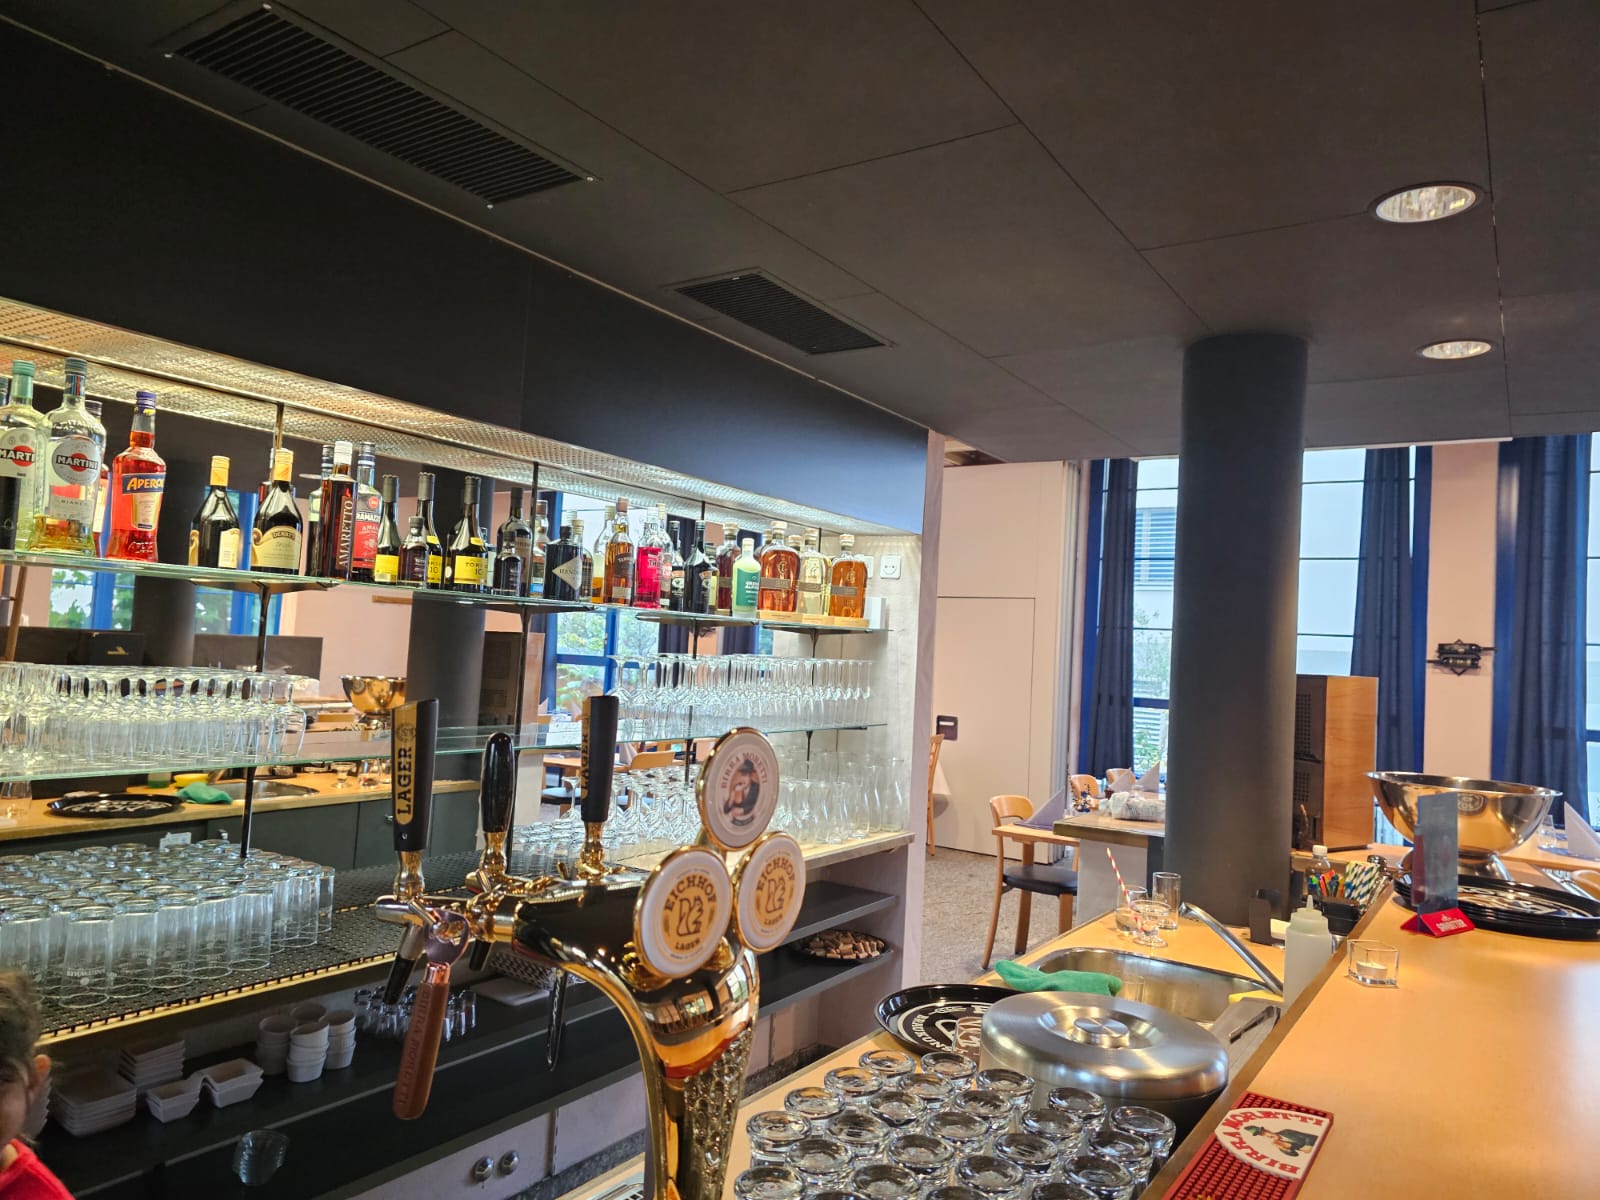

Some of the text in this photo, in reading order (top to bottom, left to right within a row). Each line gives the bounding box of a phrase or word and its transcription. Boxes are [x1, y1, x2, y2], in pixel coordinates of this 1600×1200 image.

[57, 455, 97, 469] MARTINI
[339, 500, 353, 568] AMARETTO
[397, 747, 412, 815] LAGER
[721, 752, 768, 789] BIRRA MORETTI
[756, 856, 796, 891] EICHHOF
[664, 874, 717, 912] EICHHOF
[1222, 1110, 1325, 1175] BIRRA MORETTI
